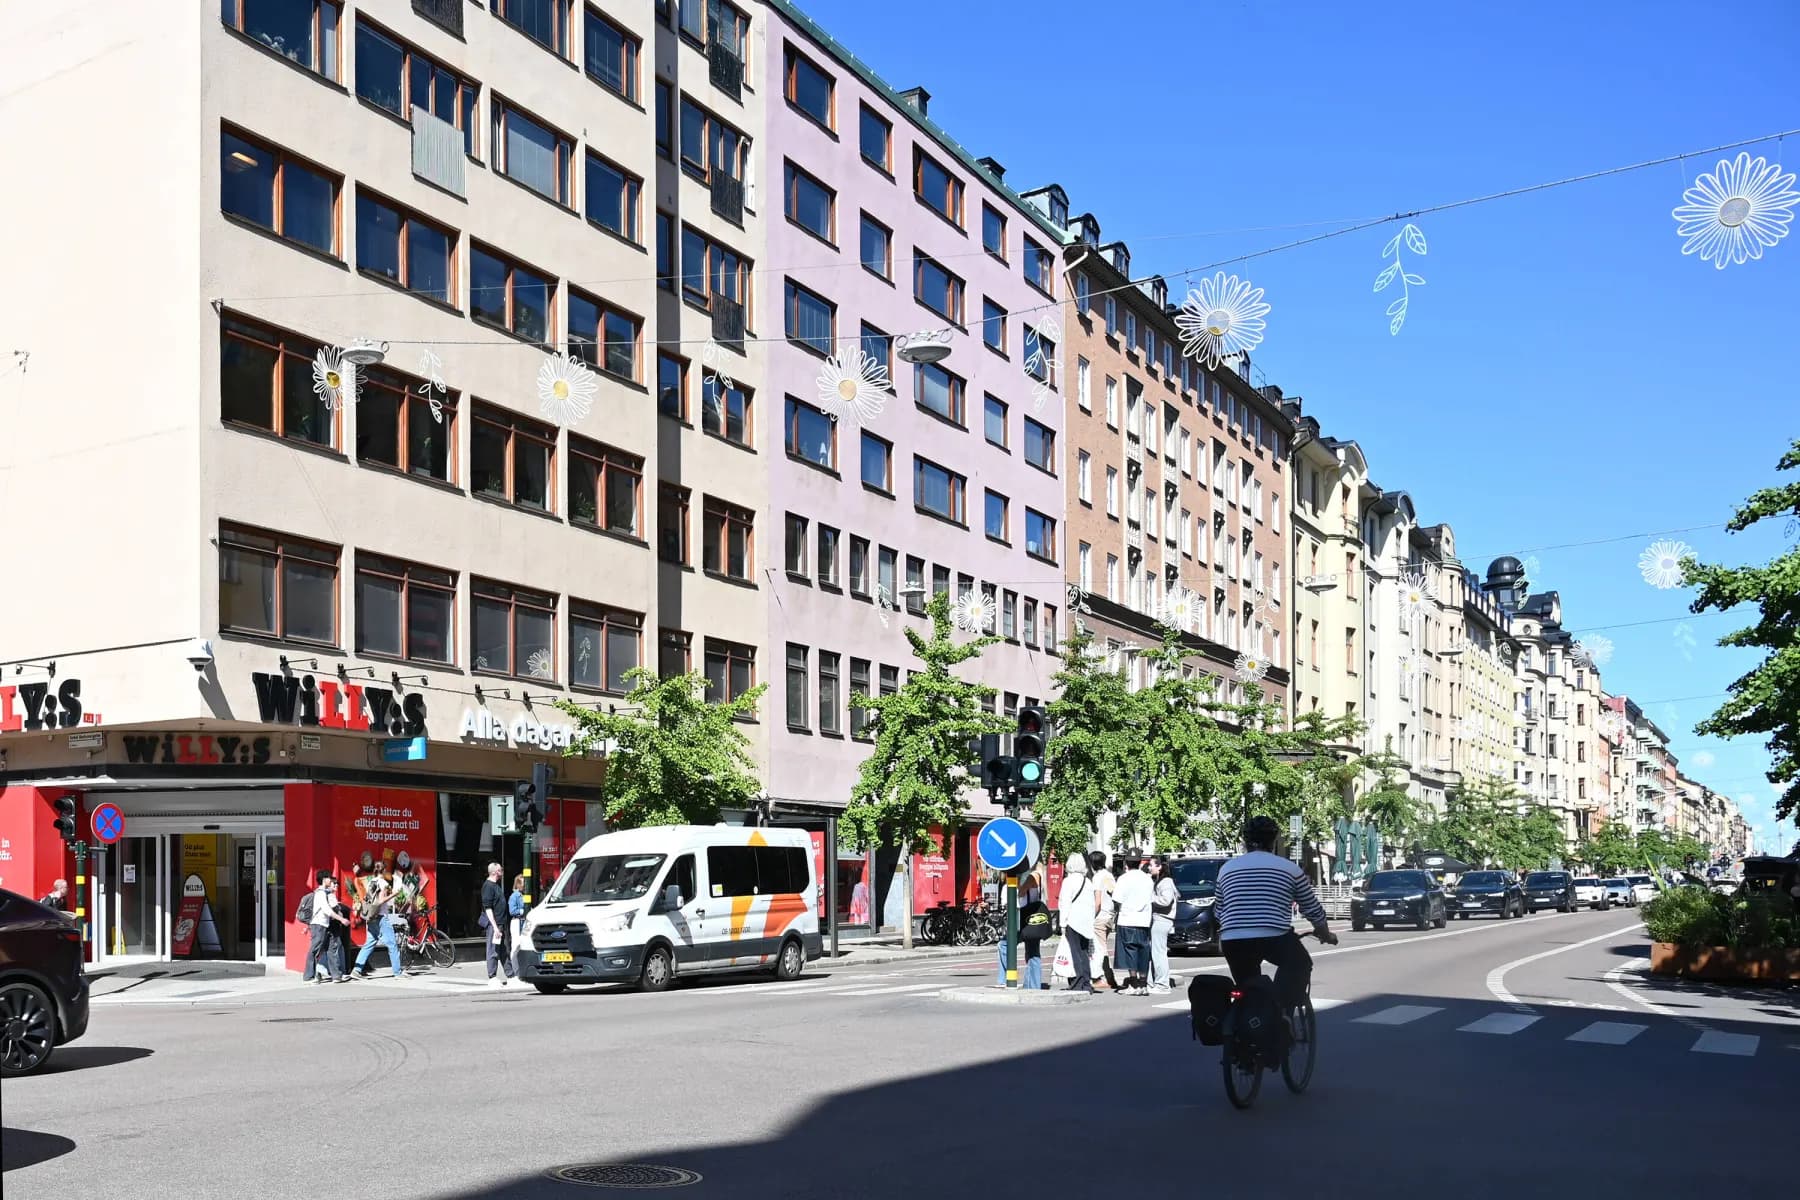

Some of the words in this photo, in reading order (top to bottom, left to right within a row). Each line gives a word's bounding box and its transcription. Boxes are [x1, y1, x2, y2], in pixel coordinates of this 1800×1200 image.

[463, 708, 506, 741] Alla
[513, 715, 576, 750] dagar
[362, 805, 378, 816] Här
[402, 808, 412, 818] du
[354, 817, 376, 828] alltid
[377, 818, 391, 829] bra
[392, 820, 408, 829] mat
[408, 819, 420, 830] till
[365, 829, 384, 842] låga
